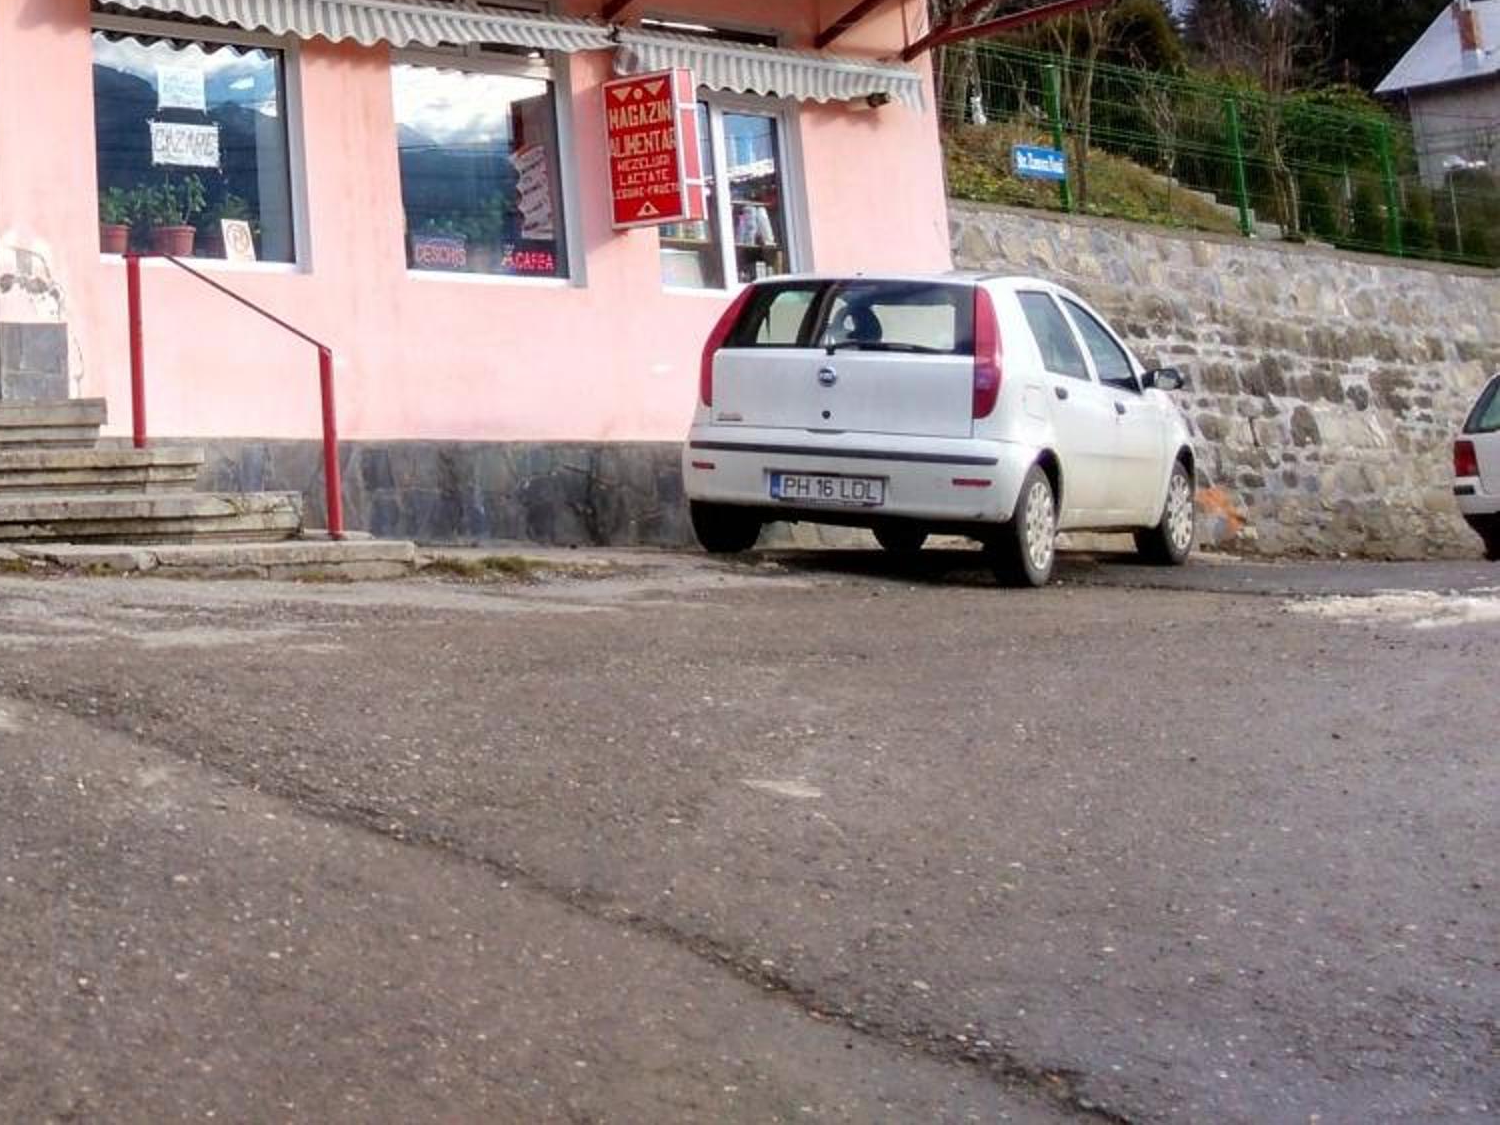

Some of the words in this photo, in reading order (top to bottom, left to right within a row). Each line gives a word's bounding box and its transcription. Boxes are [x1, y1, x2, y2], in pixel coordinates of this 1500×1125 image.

[609, 99, 672, 129] MAGAZIN
[154, 127, 215, 156] CAZARE
[619, 168, 669, 187] LACTATE
[784, 477, 810, 496] PH
[816, 479, 834, 497] 16
